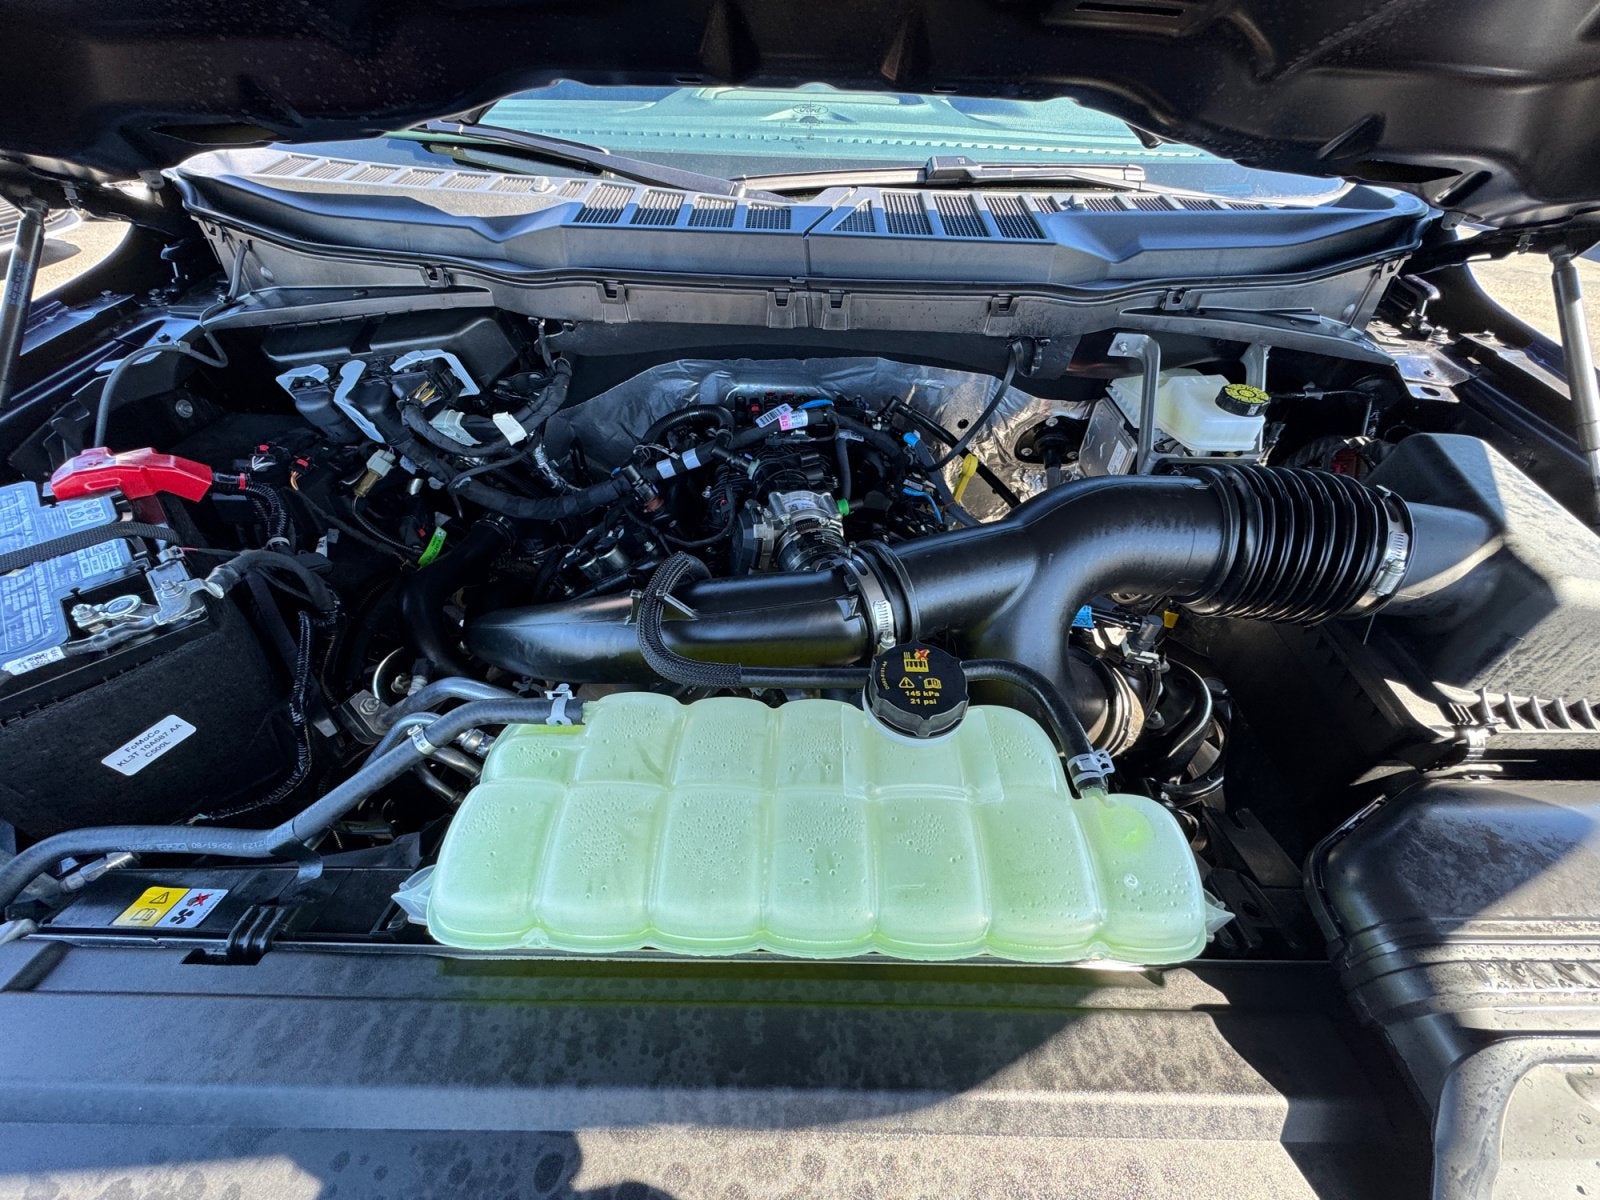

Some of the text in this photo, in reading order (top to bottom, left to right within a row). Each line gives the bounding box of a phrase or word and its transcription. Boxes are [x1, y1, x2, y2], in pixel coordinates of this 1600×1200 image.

[116, 751, 140, 767] KL3T
[169, 723, 183, 733] AA
[124, 729, 161, 753] FoMoCo
